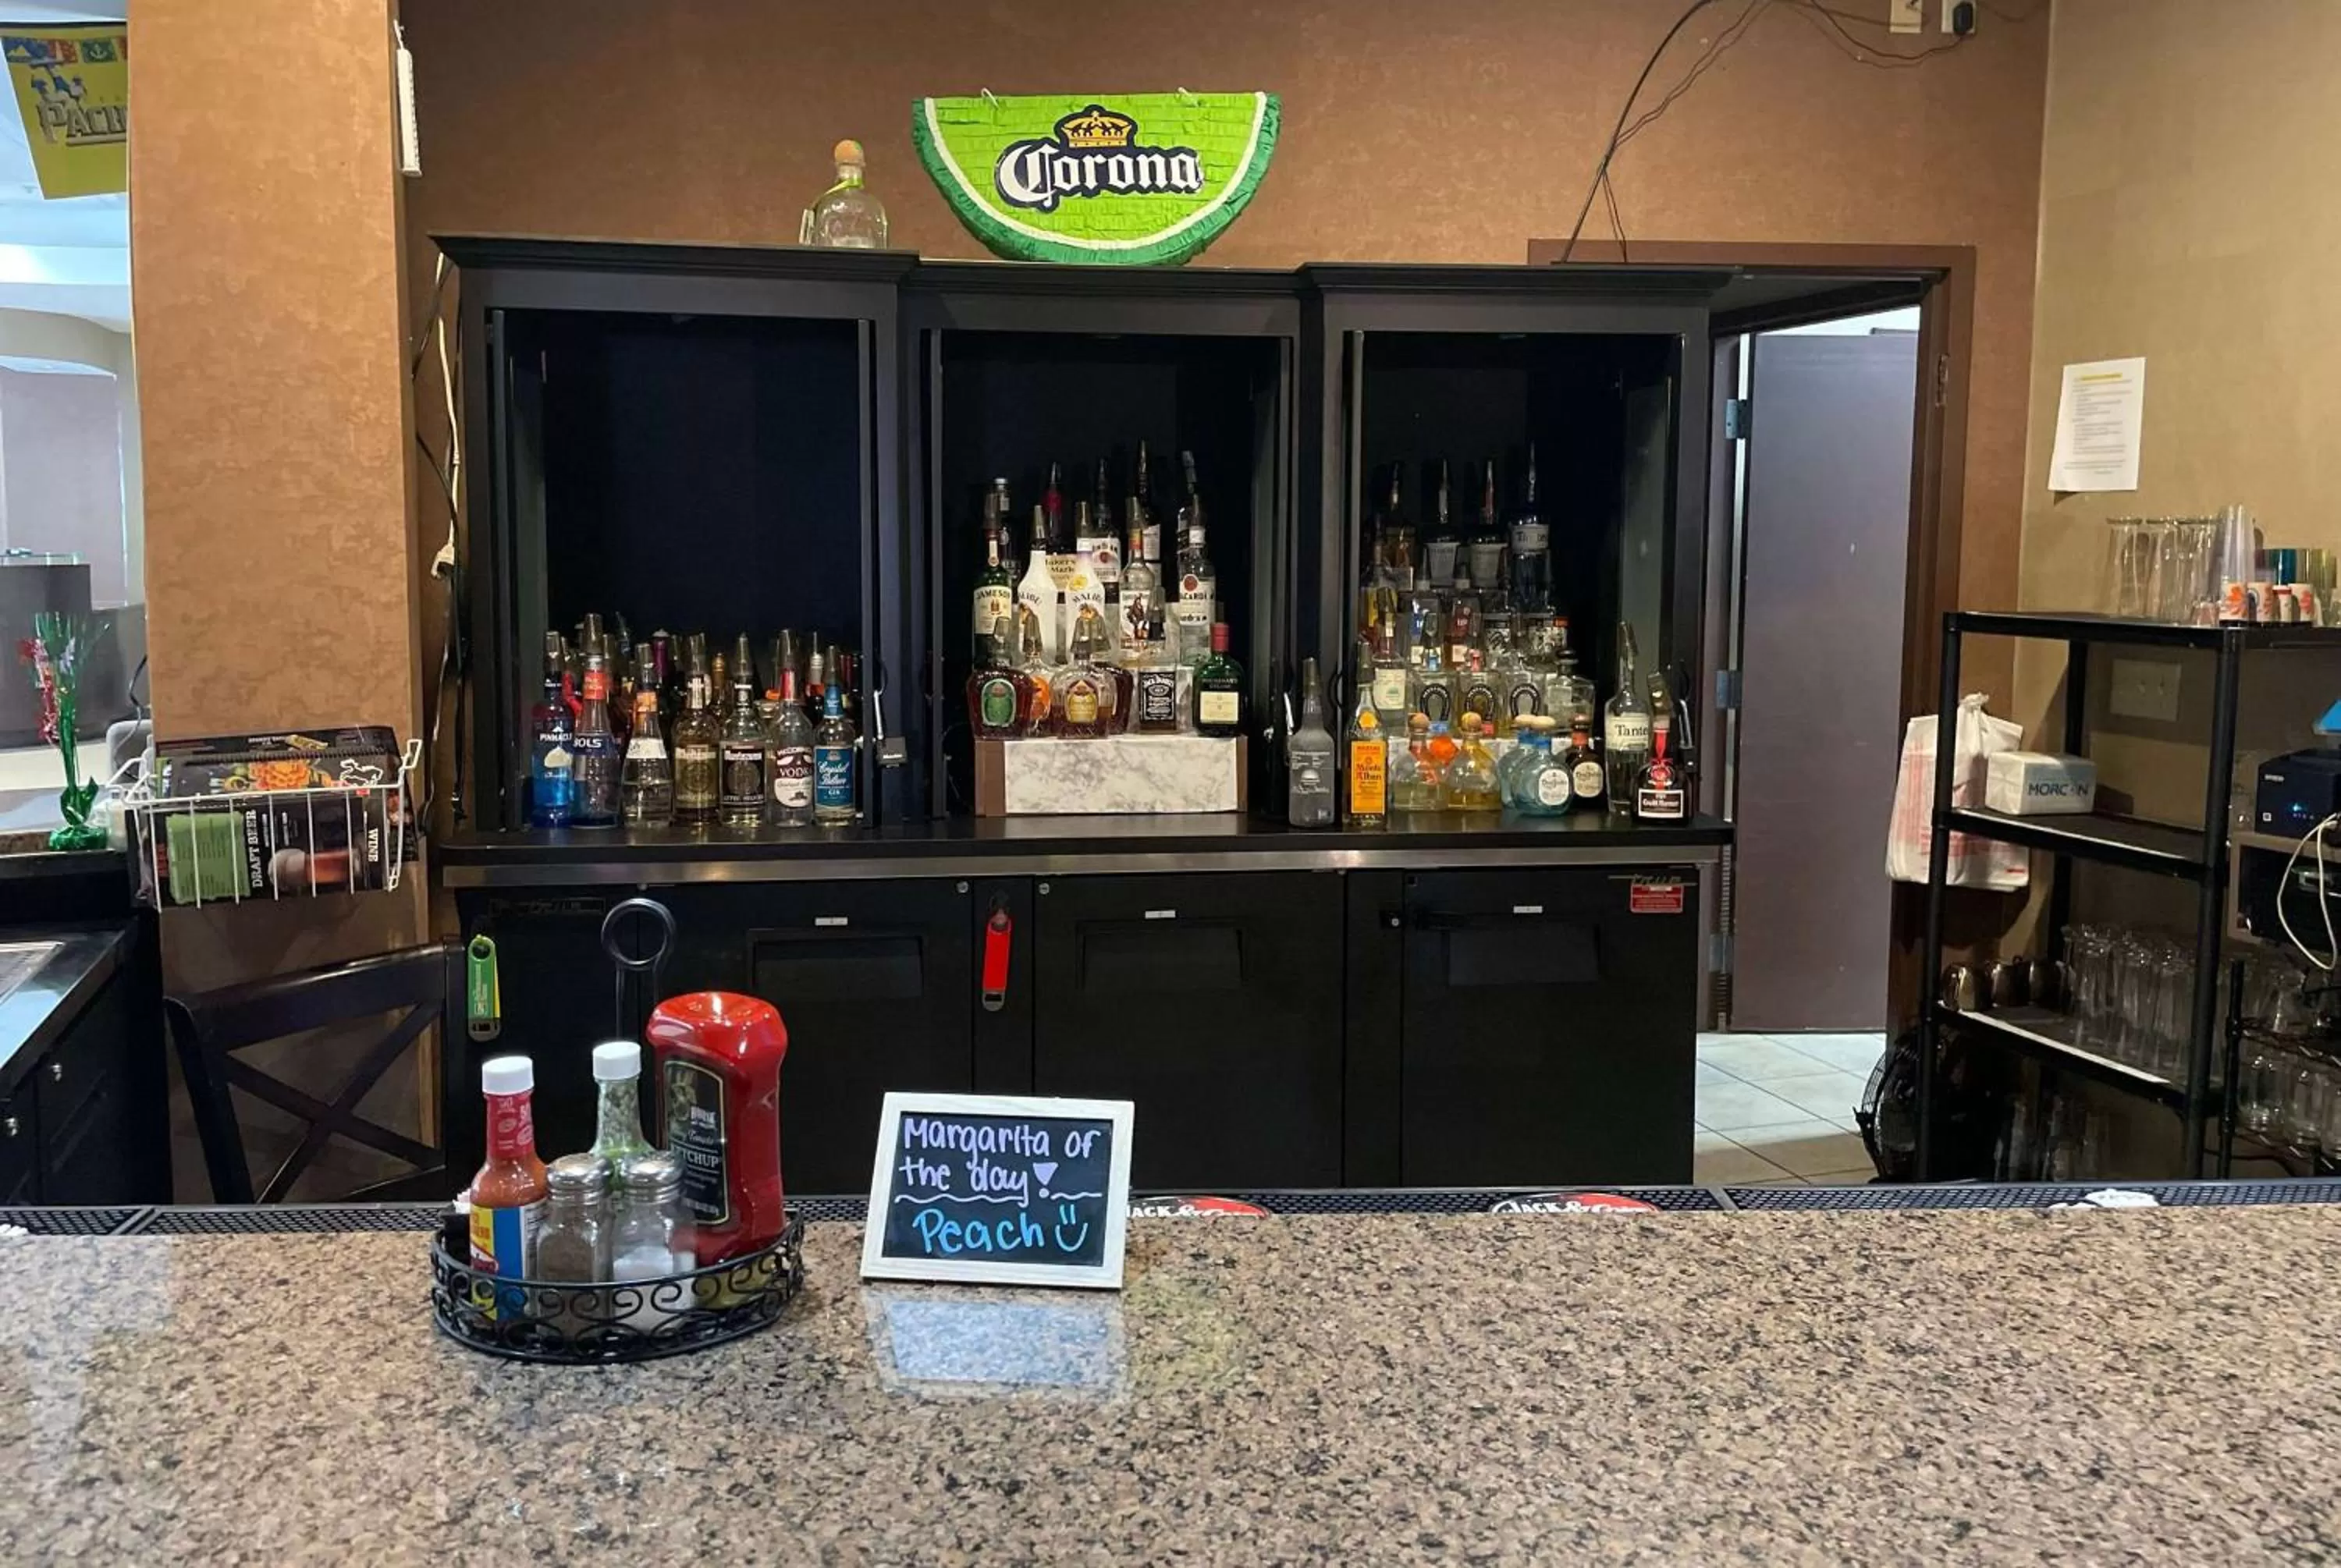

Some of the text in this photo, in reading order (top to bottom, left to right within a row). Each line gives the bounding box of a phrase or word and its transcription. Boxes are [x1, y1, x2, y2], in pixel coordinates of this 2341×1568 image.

[998, 142, 1202, 207] Corona
[2028, 782, 2090, 796] MORCN
[246, 809, 263, 888] DRAFT BEER
[368, 827, 378, 862] WINE
[903, 1118, 1050, 1168] Margarita
[898, 1155, 951, 1191] the
[911, 1208, 1046, 1254] Peach
